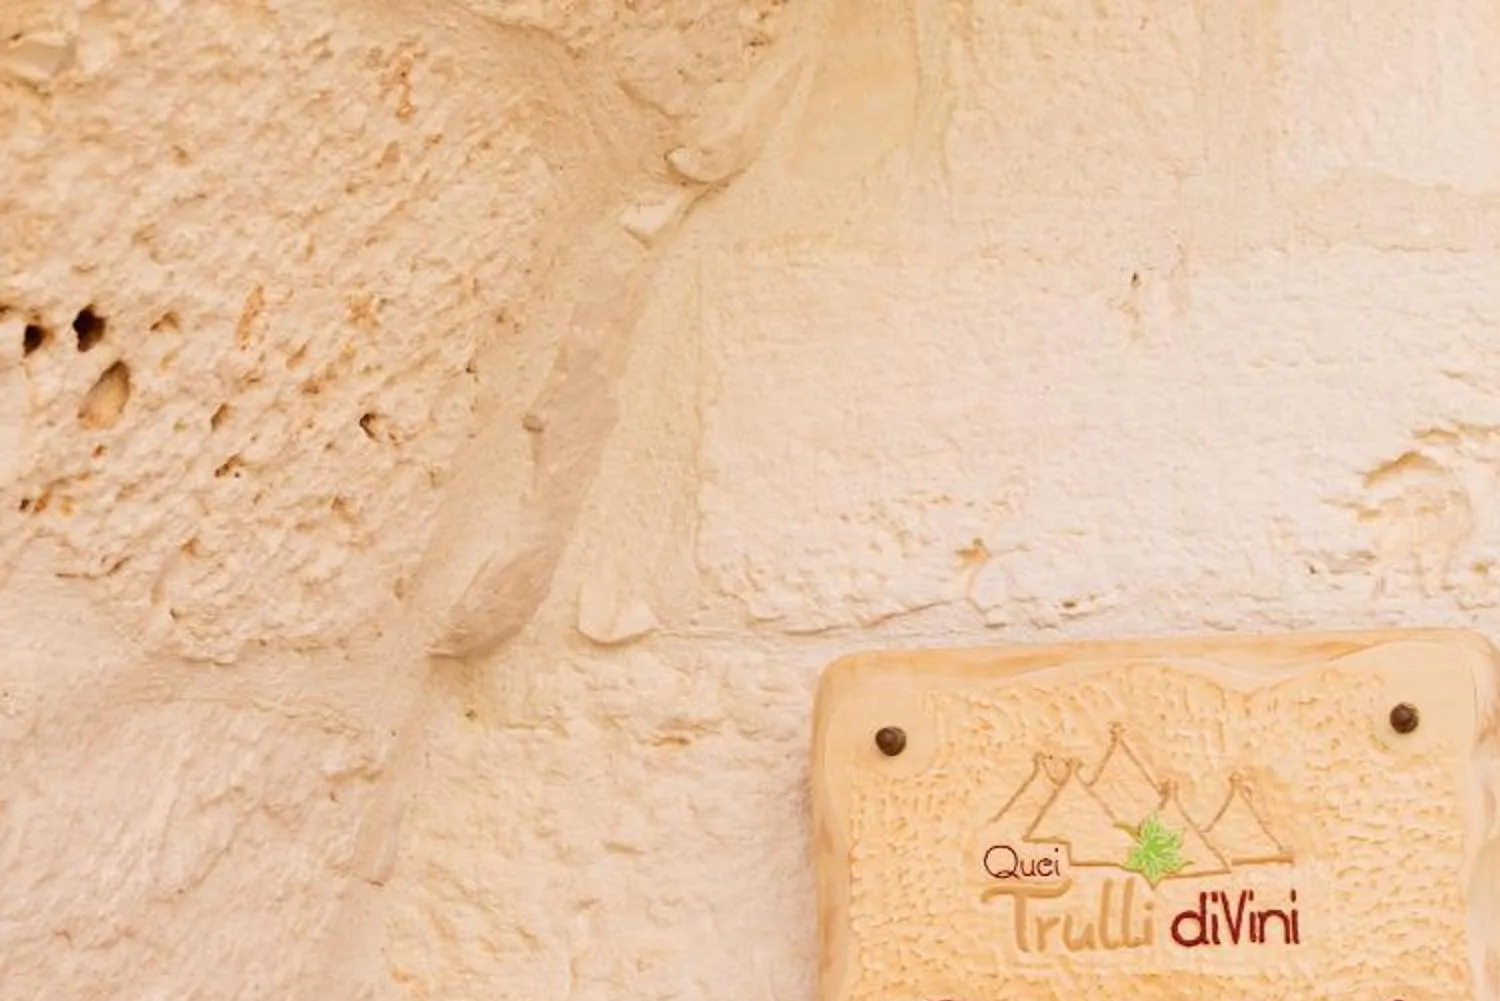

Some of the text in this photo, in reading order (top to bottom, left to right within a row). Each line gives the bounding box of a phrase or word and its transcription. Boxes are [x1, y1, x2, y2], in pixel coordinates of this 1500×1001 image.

[983, 844, 1061, 880] Quei
[981, 878, 1300, 953] Trulli diVini
